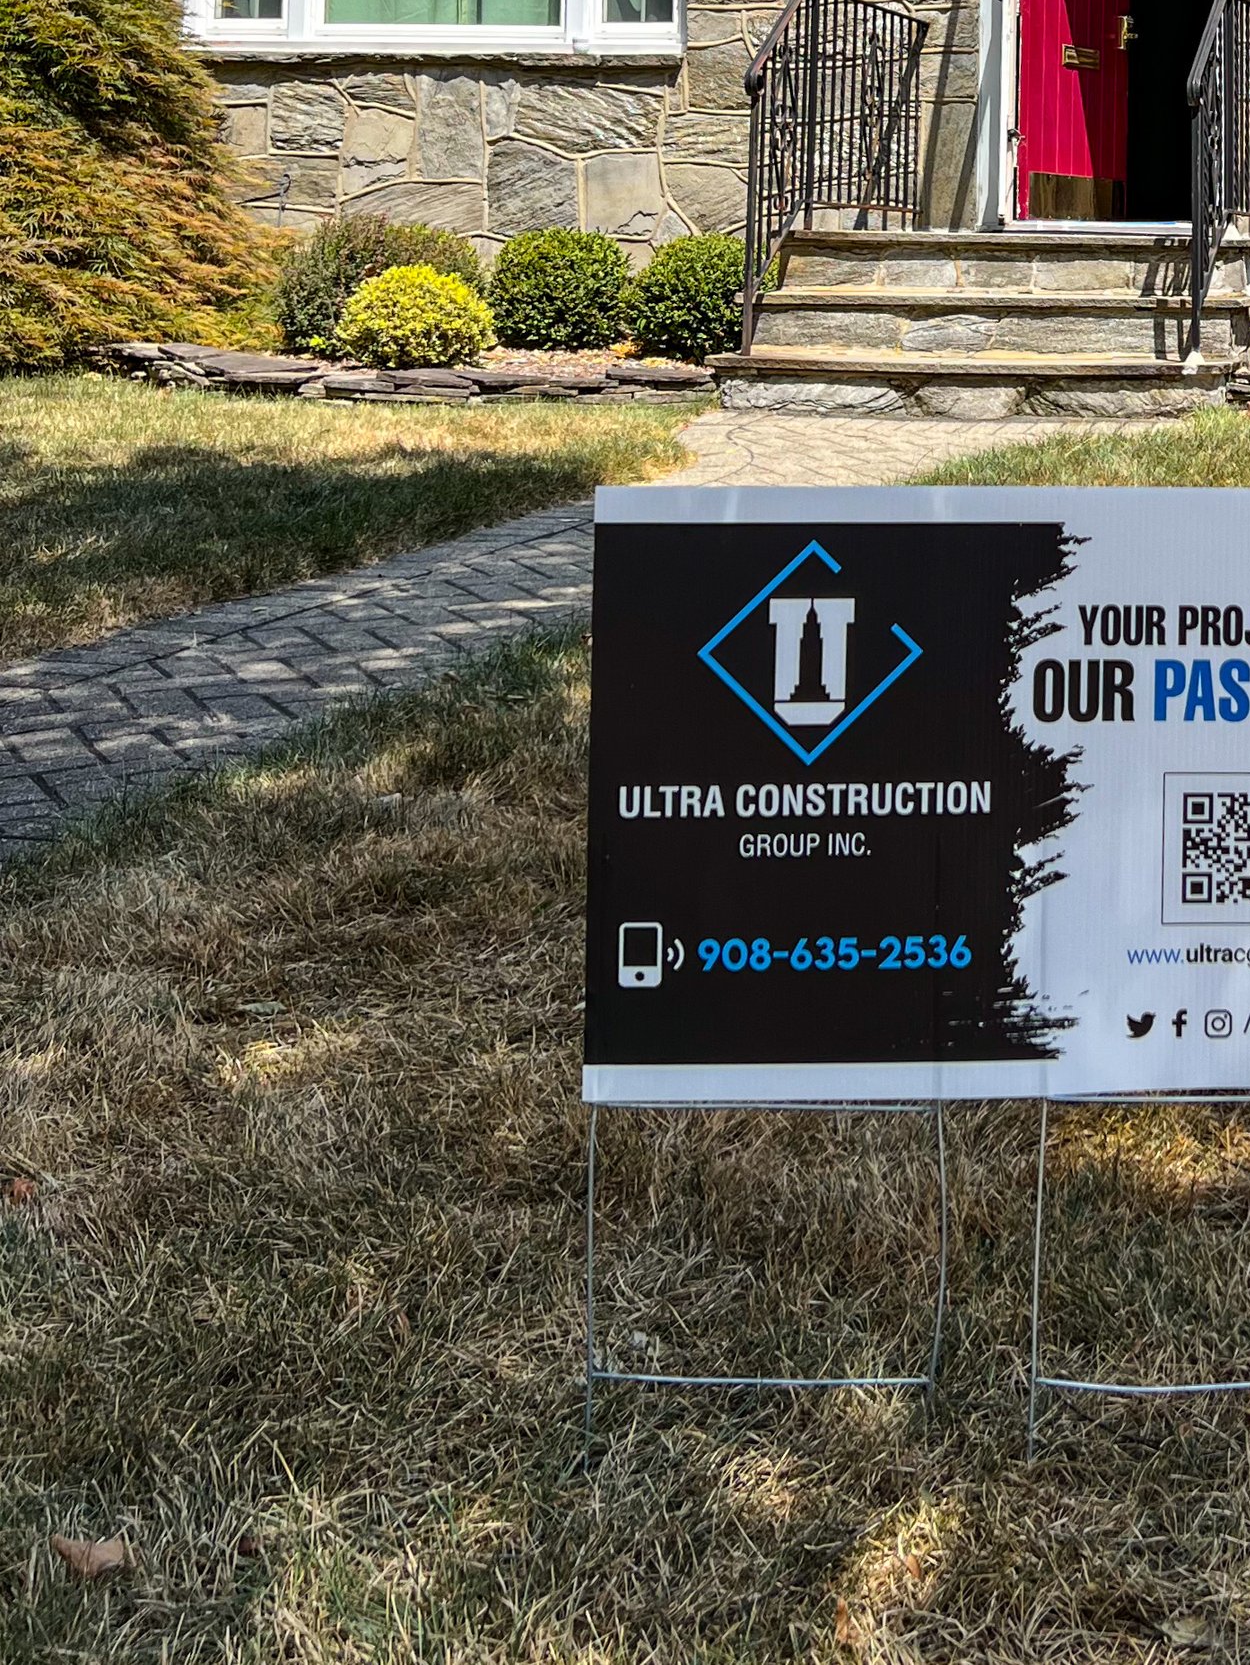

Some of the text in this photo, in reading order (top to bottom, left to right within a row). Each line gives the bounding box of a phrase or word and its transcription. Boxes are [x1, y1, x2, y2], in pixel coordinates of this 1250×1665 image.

[1078, 604, 1166, 646] YOUR
[1033, 658, 1135, 722] OUR
[618, 780, 991, 819] ULTRA CONSTRUCTION
[739, 832, 872, 858] GROUP INC.
[697, 934, 972, 972] 908-635-2536
